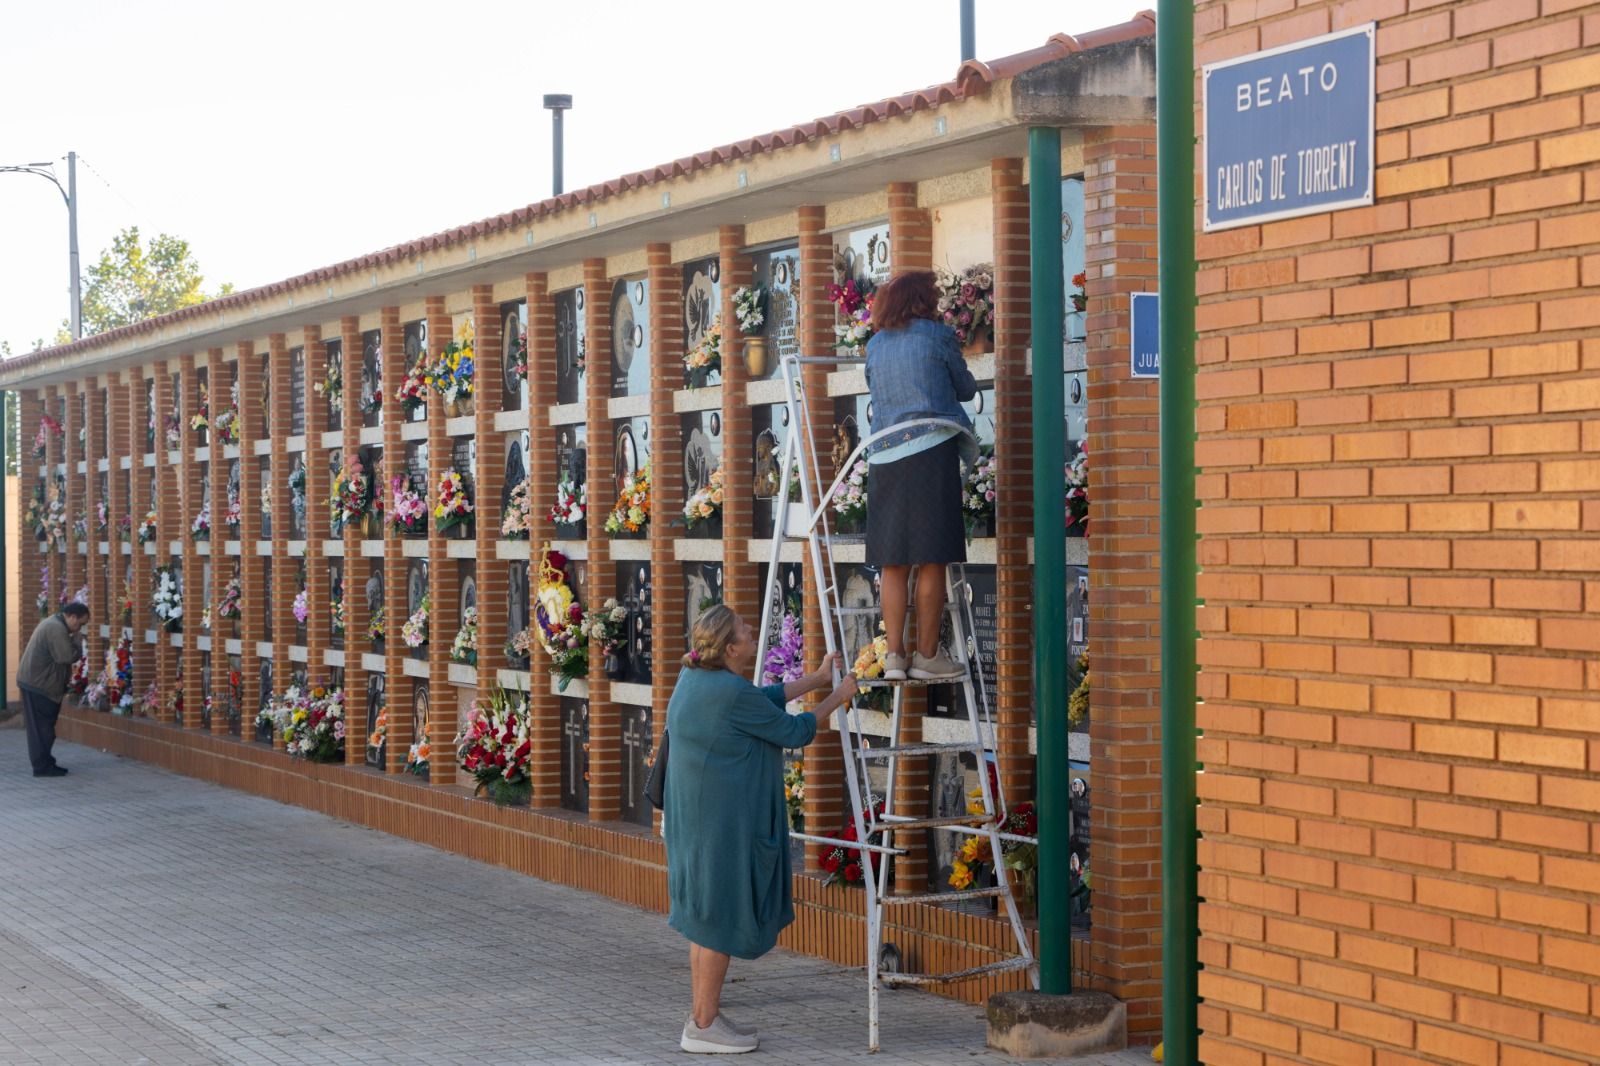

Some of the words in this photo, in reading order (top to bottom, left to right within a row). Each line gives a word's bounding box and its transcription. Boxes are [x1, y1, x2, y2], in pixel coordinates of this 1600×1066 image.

[1237, 62, 1337, 112] BEATO
[1217, 158, 1263, 210] CARLOS
[1270, 154, 1287, 200] DE
[1298, 140, 1356, 196] TORRENT
